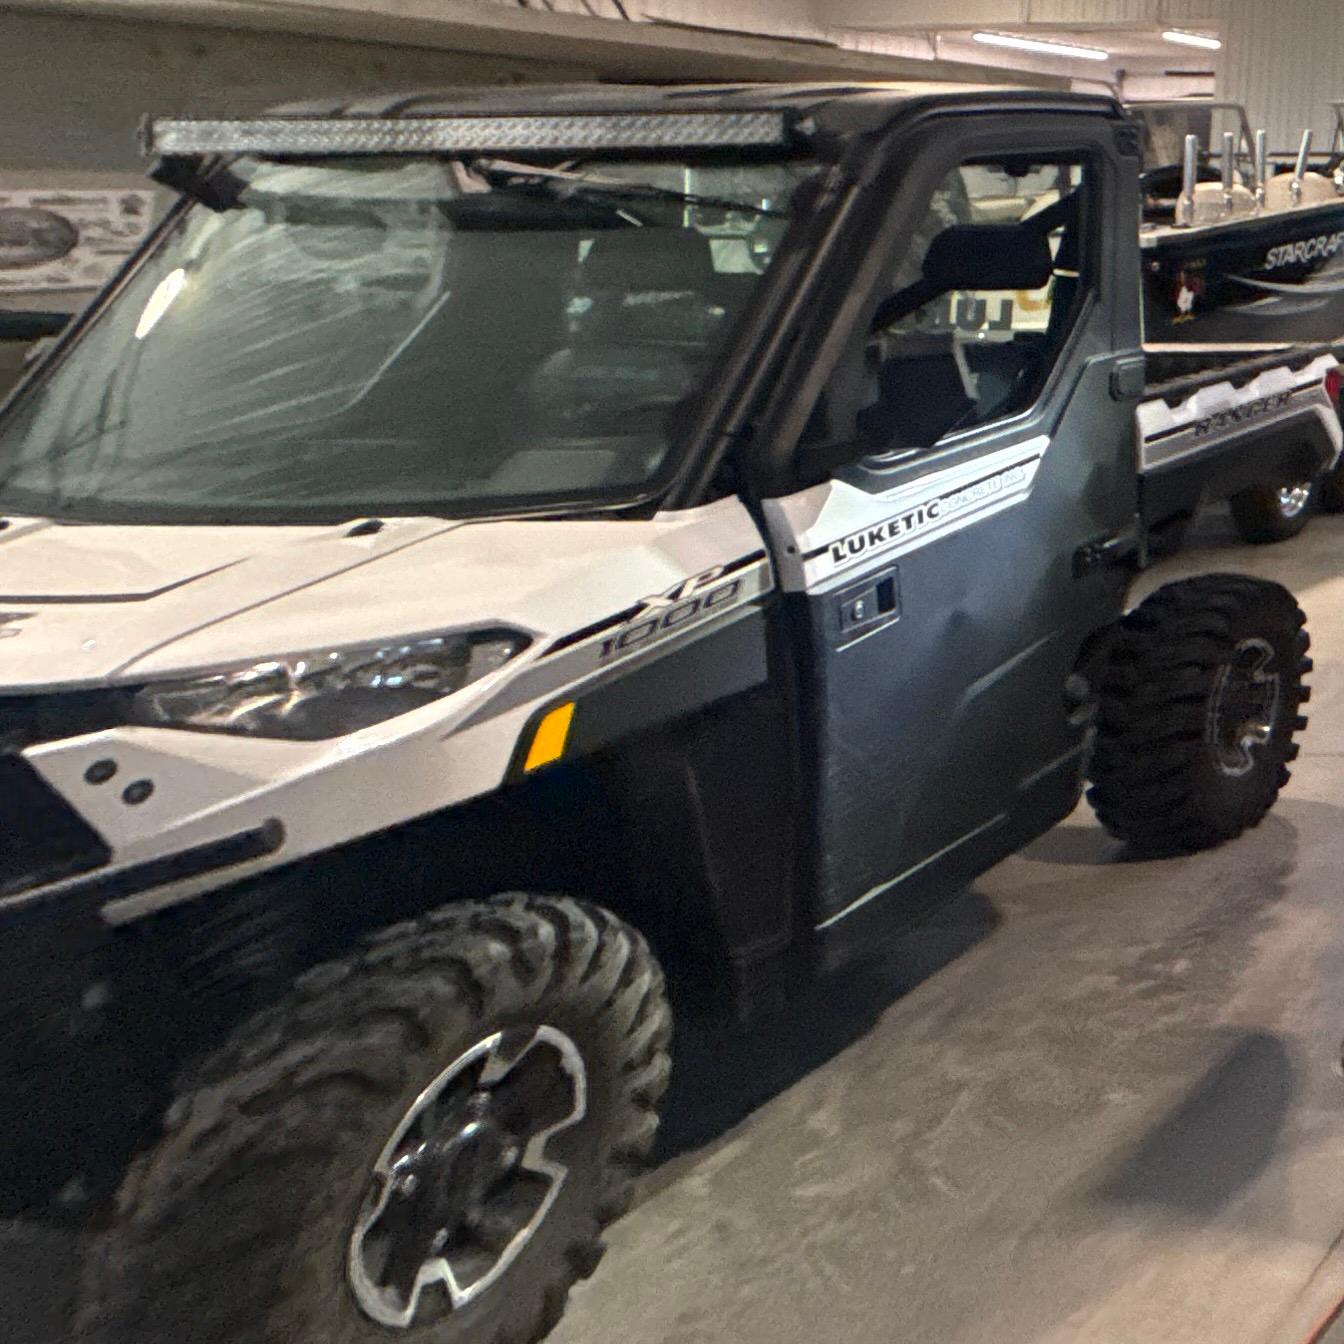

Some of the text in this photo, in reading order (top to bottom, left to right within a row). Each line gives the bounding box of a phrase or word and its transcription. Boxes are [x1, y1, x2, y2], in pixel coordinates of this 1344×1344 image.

[831, 502, 940, 563] LUKETIC
[601, 579, 741, 657] 1000
[628, 564, 725, 623] XP
